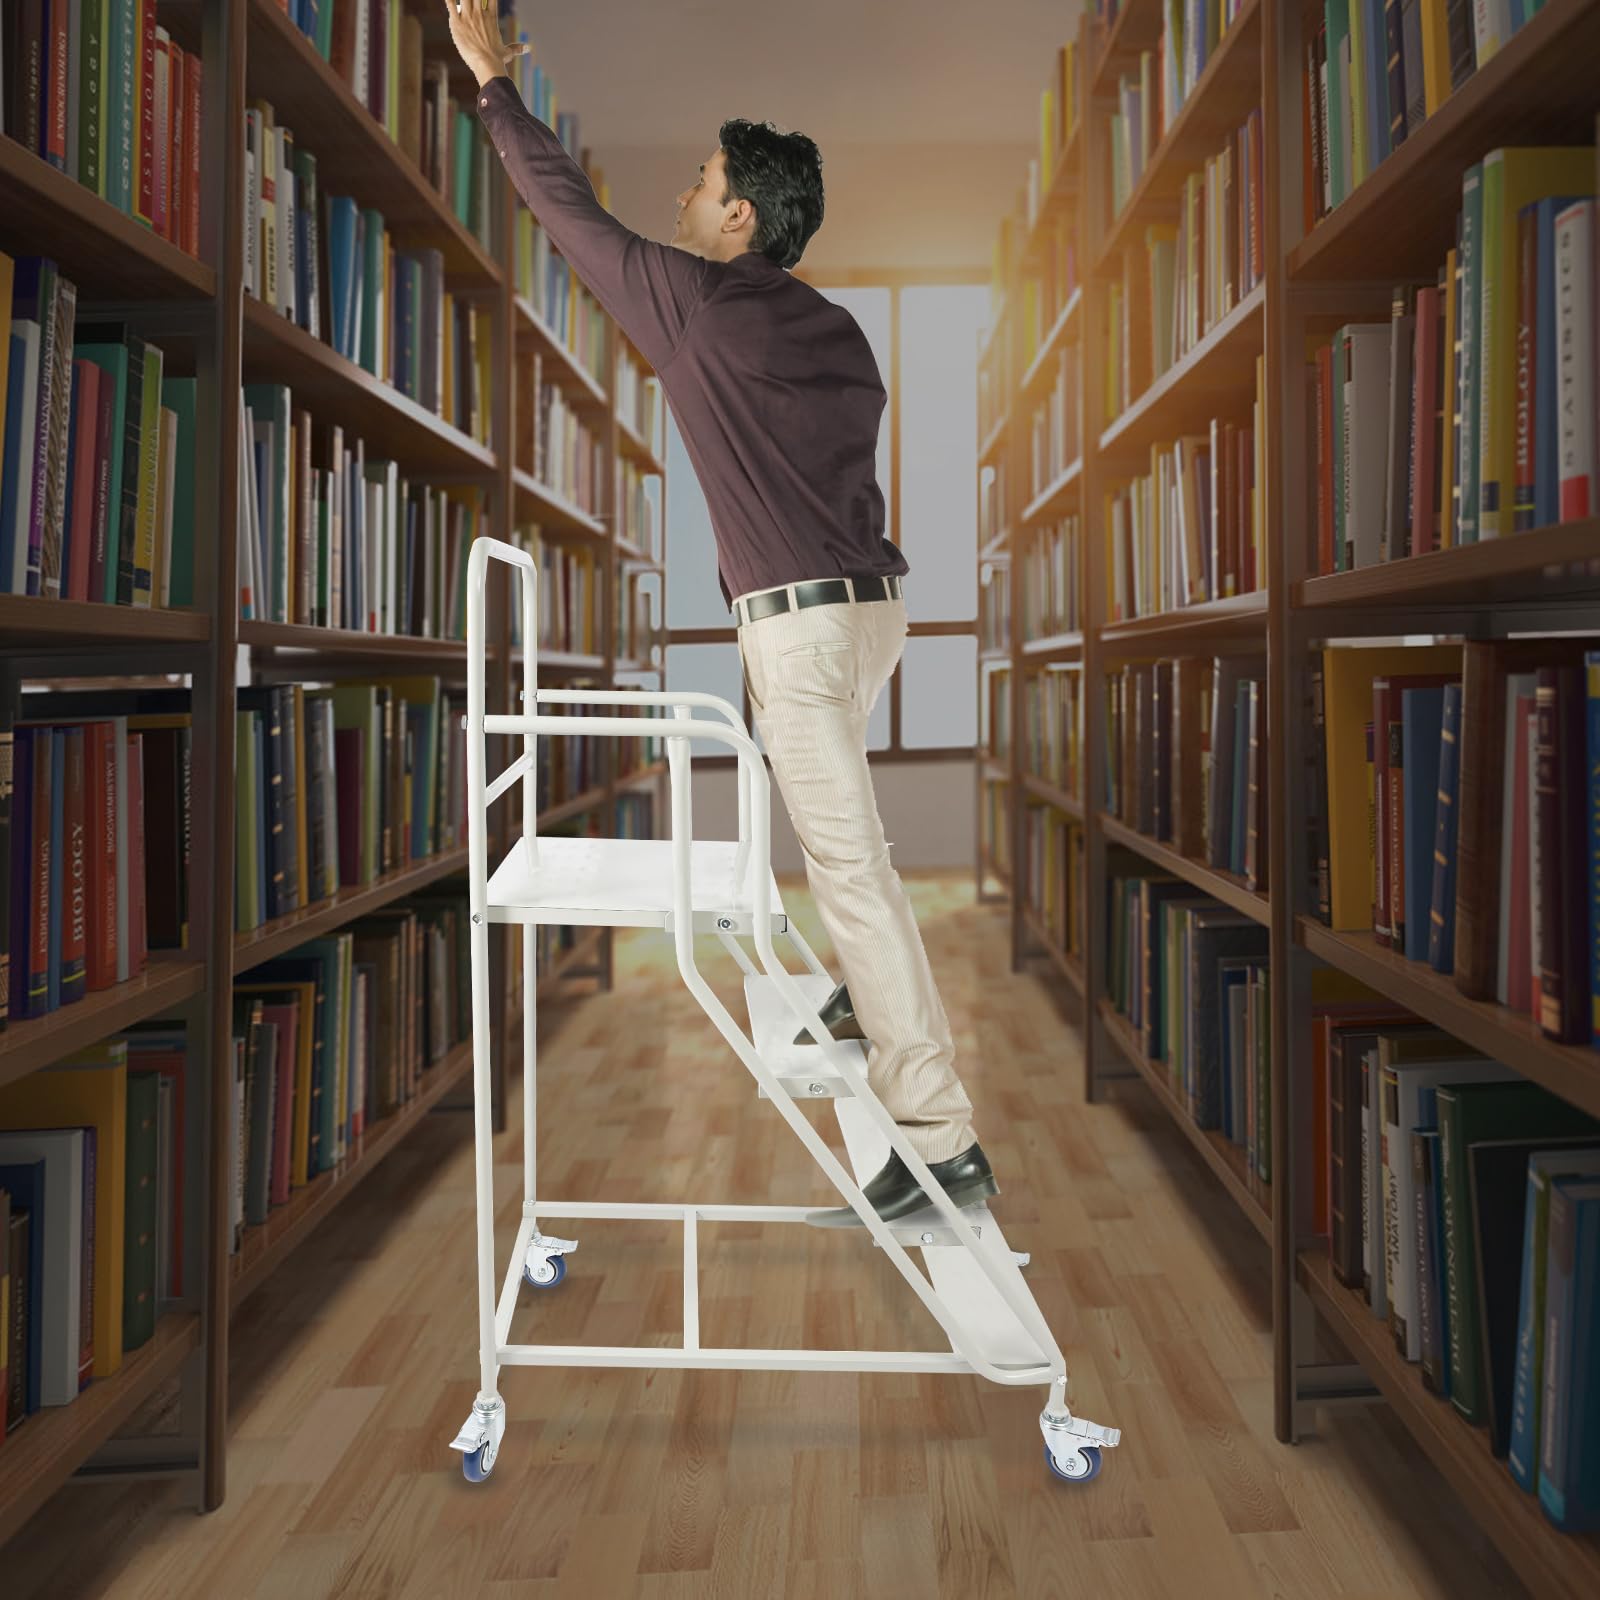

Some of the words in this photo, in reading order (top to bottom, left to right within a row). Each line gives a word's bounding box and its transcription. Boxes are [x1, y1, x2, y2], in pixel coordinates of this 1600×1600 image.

[88, 33, 98, 178] BIOLOGY
[144, 12, 154, 195] PSYCHOLOGY
[1517, 323, 1528, 466] BIOLOGY
[1562, 230, 1573, 467] STATISTICS
[38, 391, 51, 465] TRAINING
[34, 469, 46, 527] SPORTS
[39, 837, 49, 954] ENDOCRINOLOGY
[72, 822, 85, 942] BIOLOGY
[1390, 1168, 1400, 1265] ANATOMY
[1442, 1184, 1461, 1374] DICTIONARY
